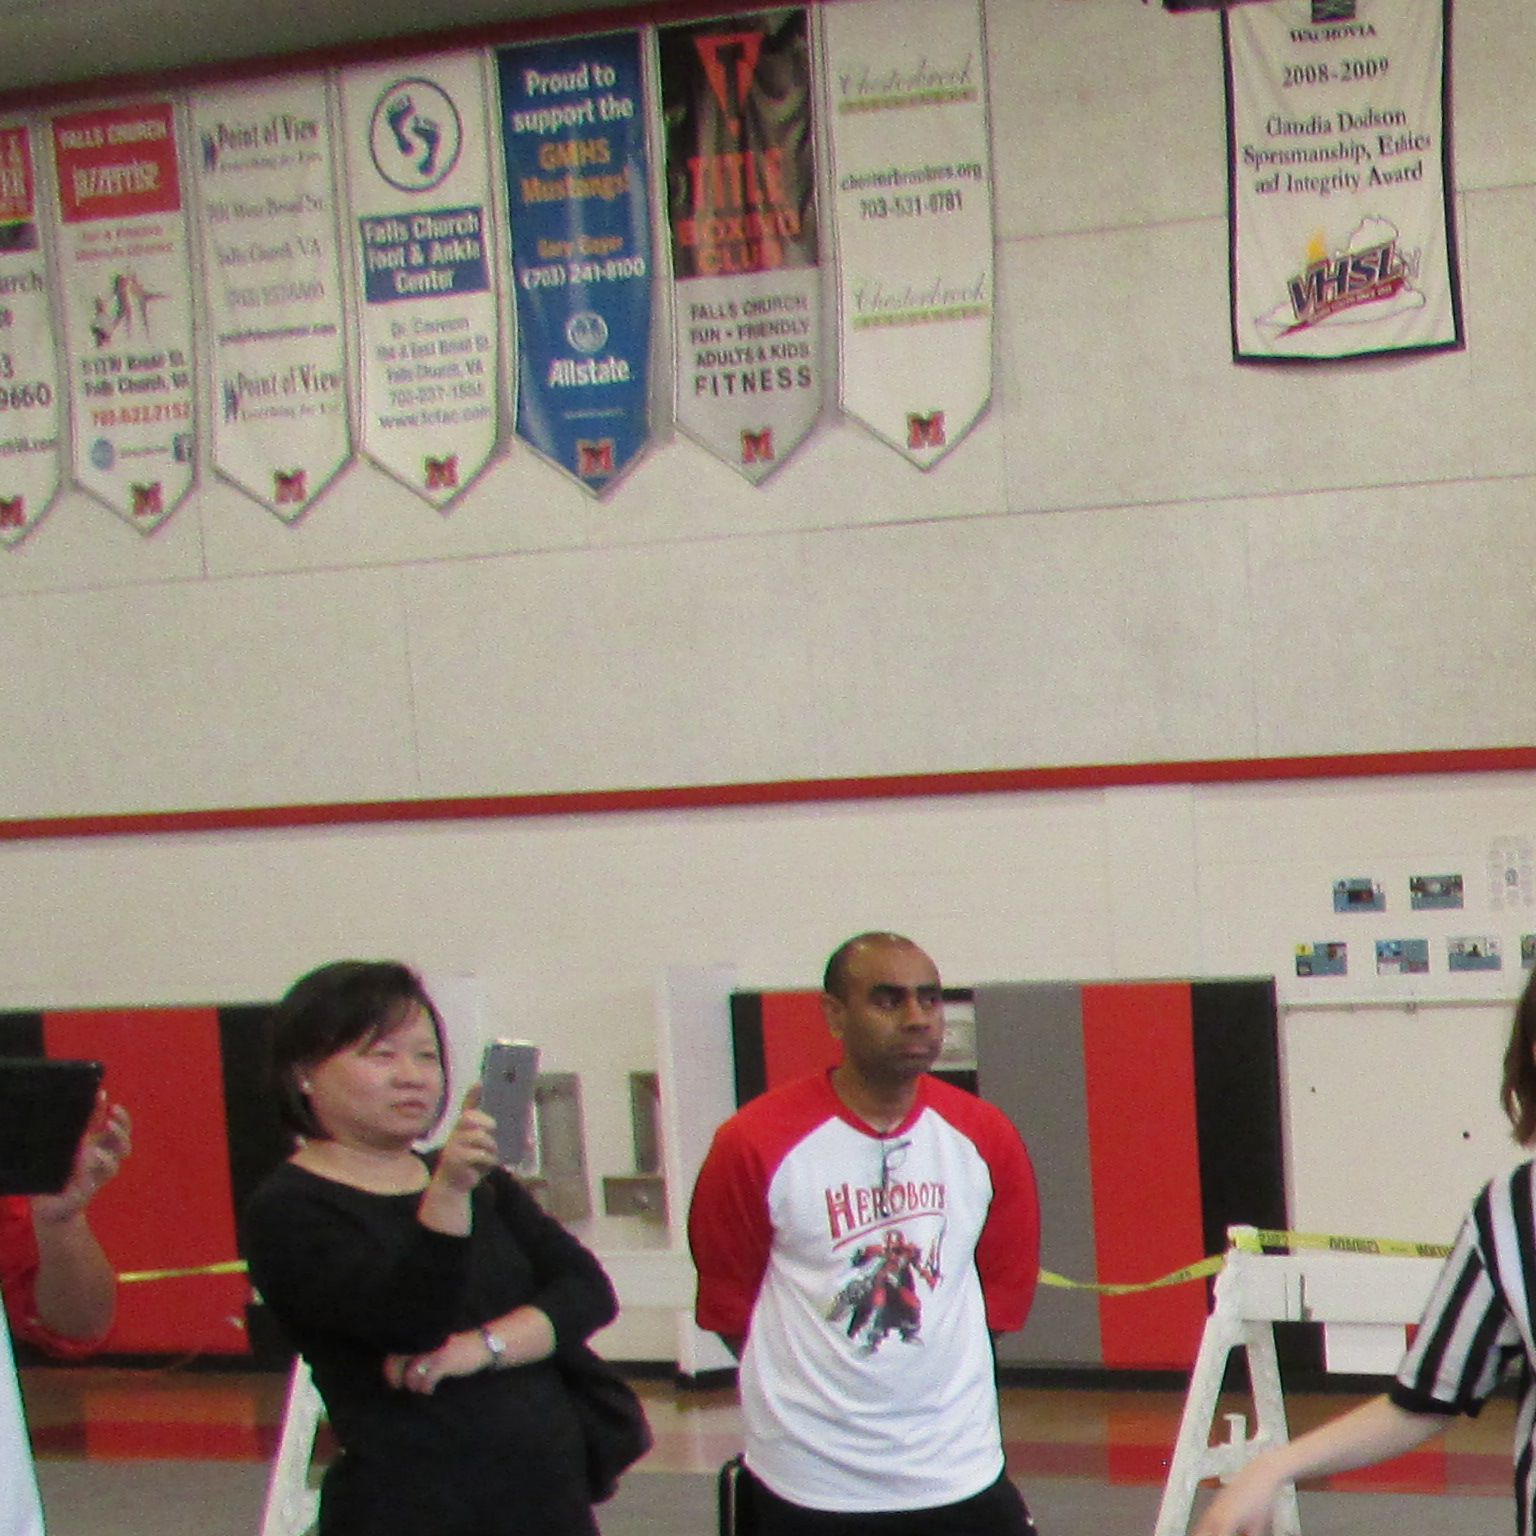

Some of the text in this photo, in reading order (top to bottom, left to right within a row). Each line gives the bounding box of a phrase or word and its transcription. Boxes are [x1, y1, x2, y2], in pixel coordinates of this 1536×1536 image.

[1290, 24, 1377, 43] WACHOVIA
[525, 63, 616, 96] Proud to
[1282, 58, 1389, 88] 2008-2009
[511, 94, 634, 134] support the
[1266, 106, 1406, 137] Claudia Dodson
[60, 119, 167, 150] FALLS CHURCH
[217, 123, 258, 149] Point
[264, 117, 279, 145] of
[687, 147, 786, 211] TITLE
[1255, 160, 1423, 196] and Integrity Award
[364, 213, 480, 245] Falls Church
[676, 207, 800, 247] BOXING
[367, 238, 481, 272] Foot & Ankle
[698, 240, 784, 275] CLUB
[395, 269, 456, 295] Center
[1288, 240, 1403, 321] VHSL
[690, 296, 807, 321] FALLS CHURCH
[690, 319, 809, 345] FUN FRIENDLY
[696, 342, 809, 368] ADULTS & KIDS
[237, 363, 341, 397] Point of View
[548, 356, 631, 388] Allstate
[694, 364, 812, 397] FITNESS
[741, 426, 775, 464] M
[906, 411, 946, 448] M
[577, 438, 614, 476] M
